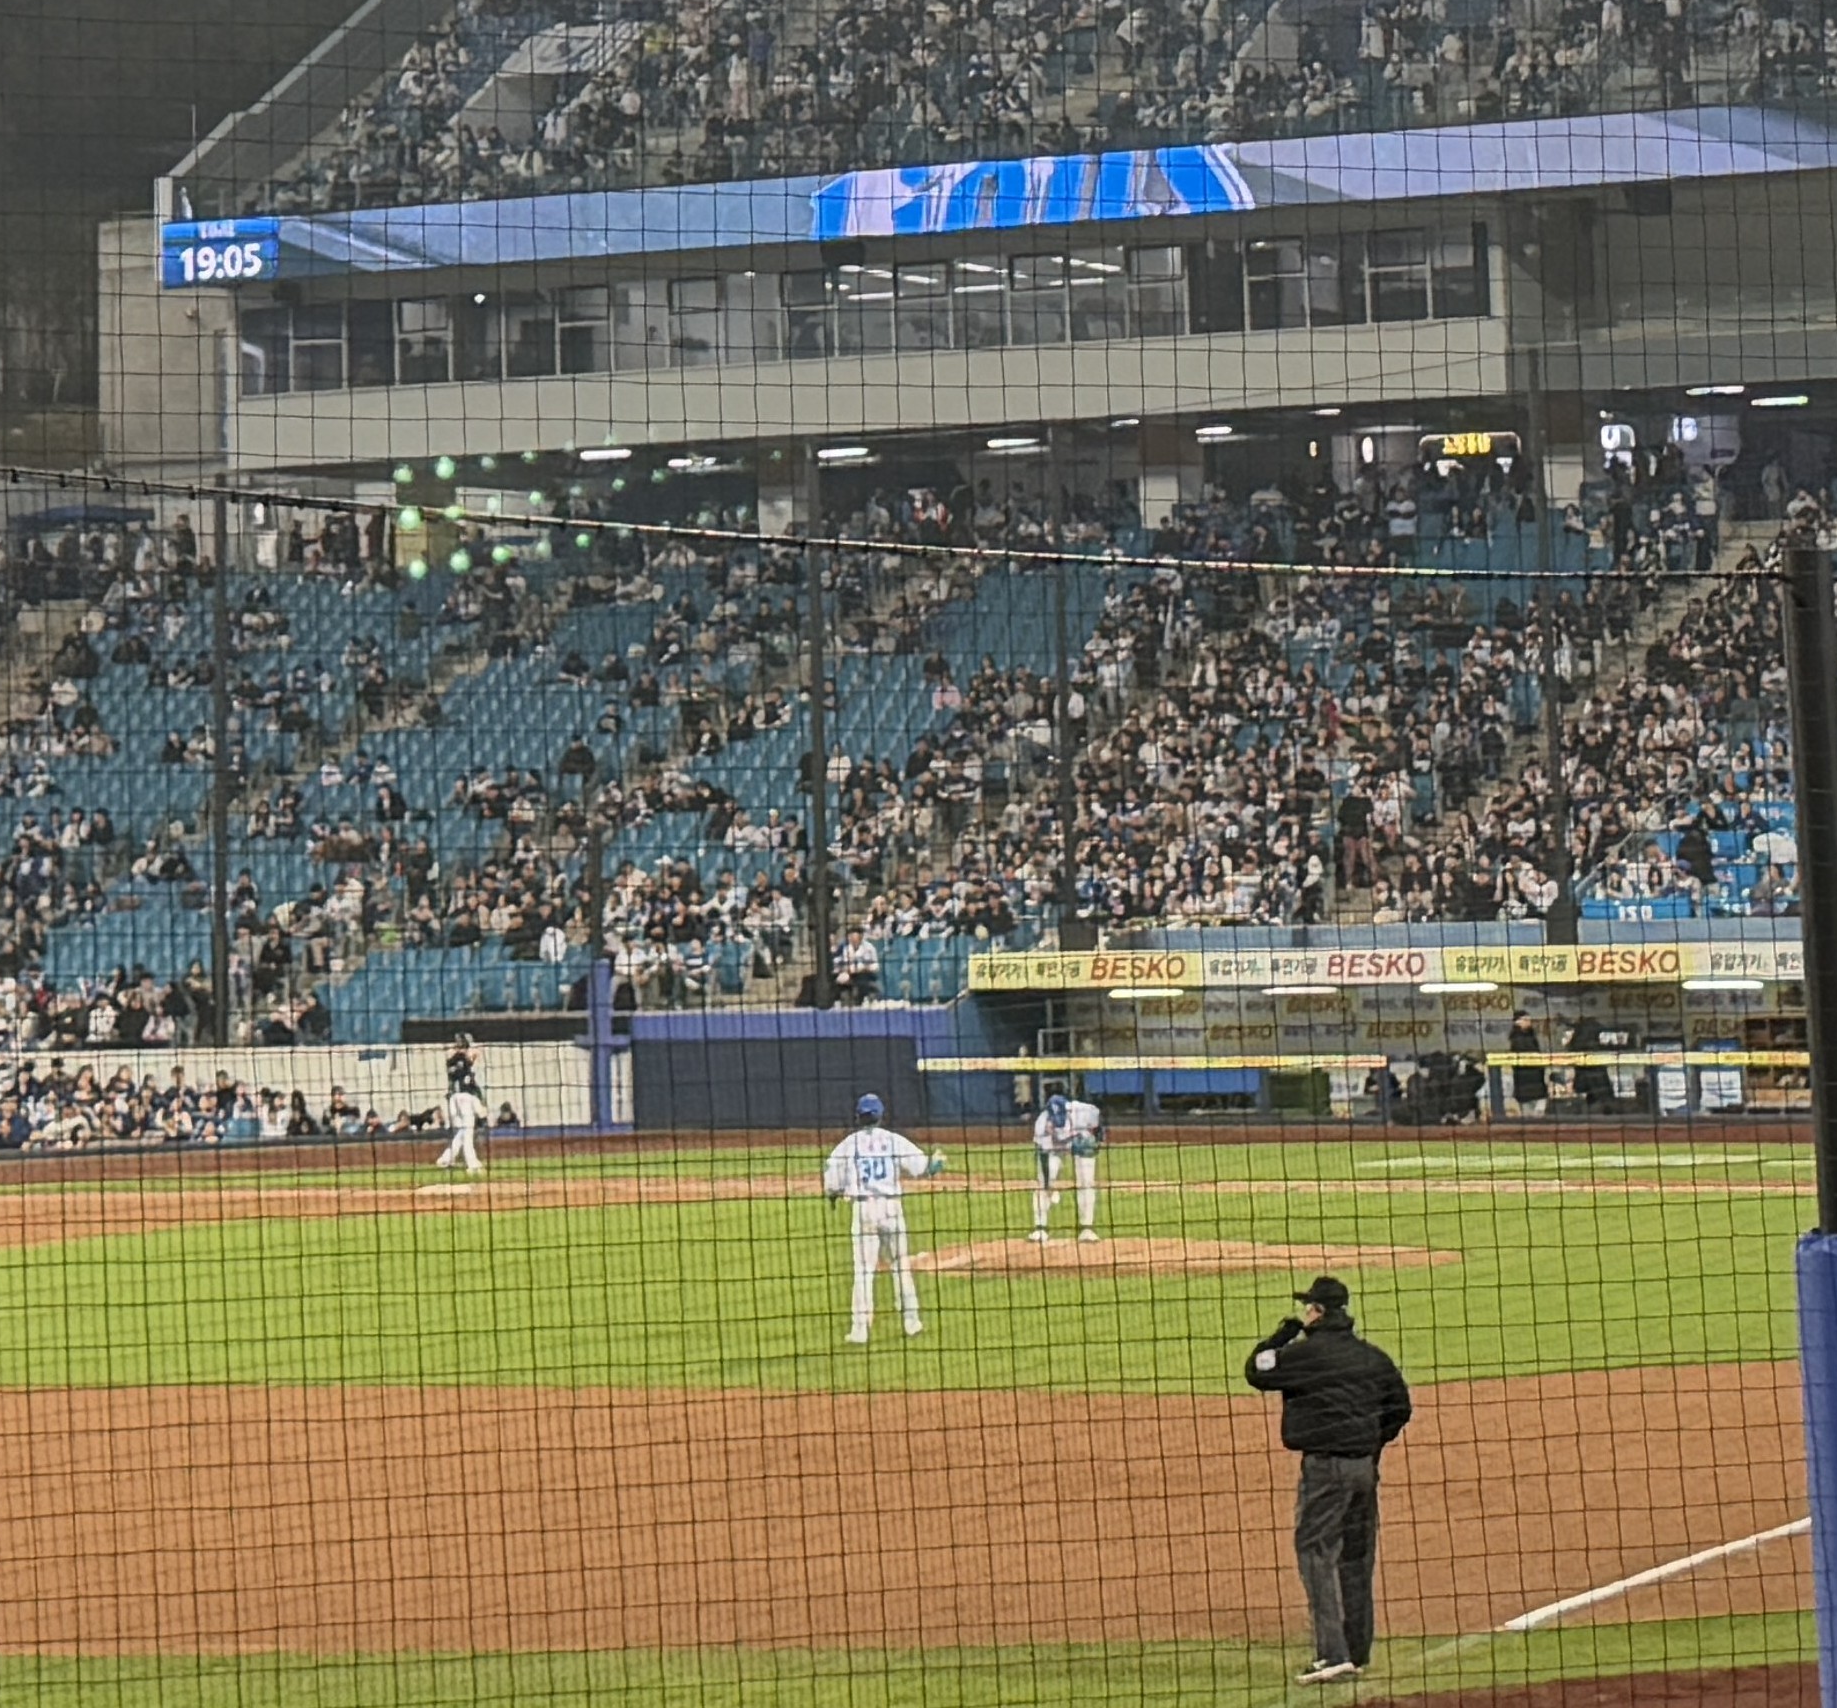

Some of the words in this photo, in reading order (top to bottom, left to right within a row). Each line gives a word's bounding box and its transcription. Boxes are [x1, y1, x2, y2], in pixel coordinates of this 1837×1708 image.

[179, 243, 262, 281] 19:05
[1090, 955, 1185, 980] BESKO
[1327, 952, 1425, 977] BESKO
[1579, 949, 1680, 975] BESKO
